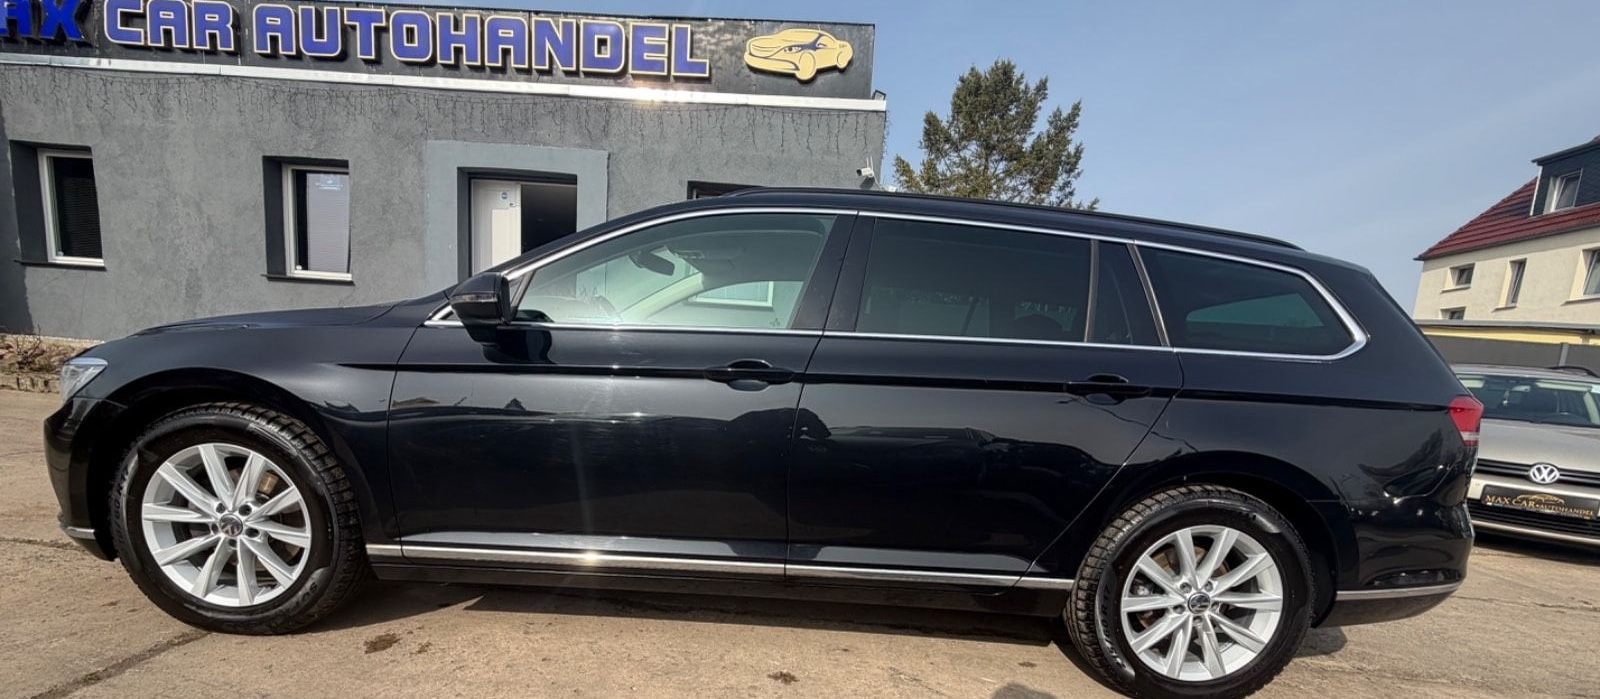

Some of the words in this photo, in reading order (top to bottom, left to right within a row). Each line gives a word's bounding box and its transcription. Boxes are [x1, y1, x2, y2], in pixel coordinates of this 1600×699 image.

[104, 0, 234, 50] CAR
[252, 4, 710, 78] AUTOHANDEL
[1486, 495, 1510, 504] MAX
[1512, 496, 1536, 508] CAR
